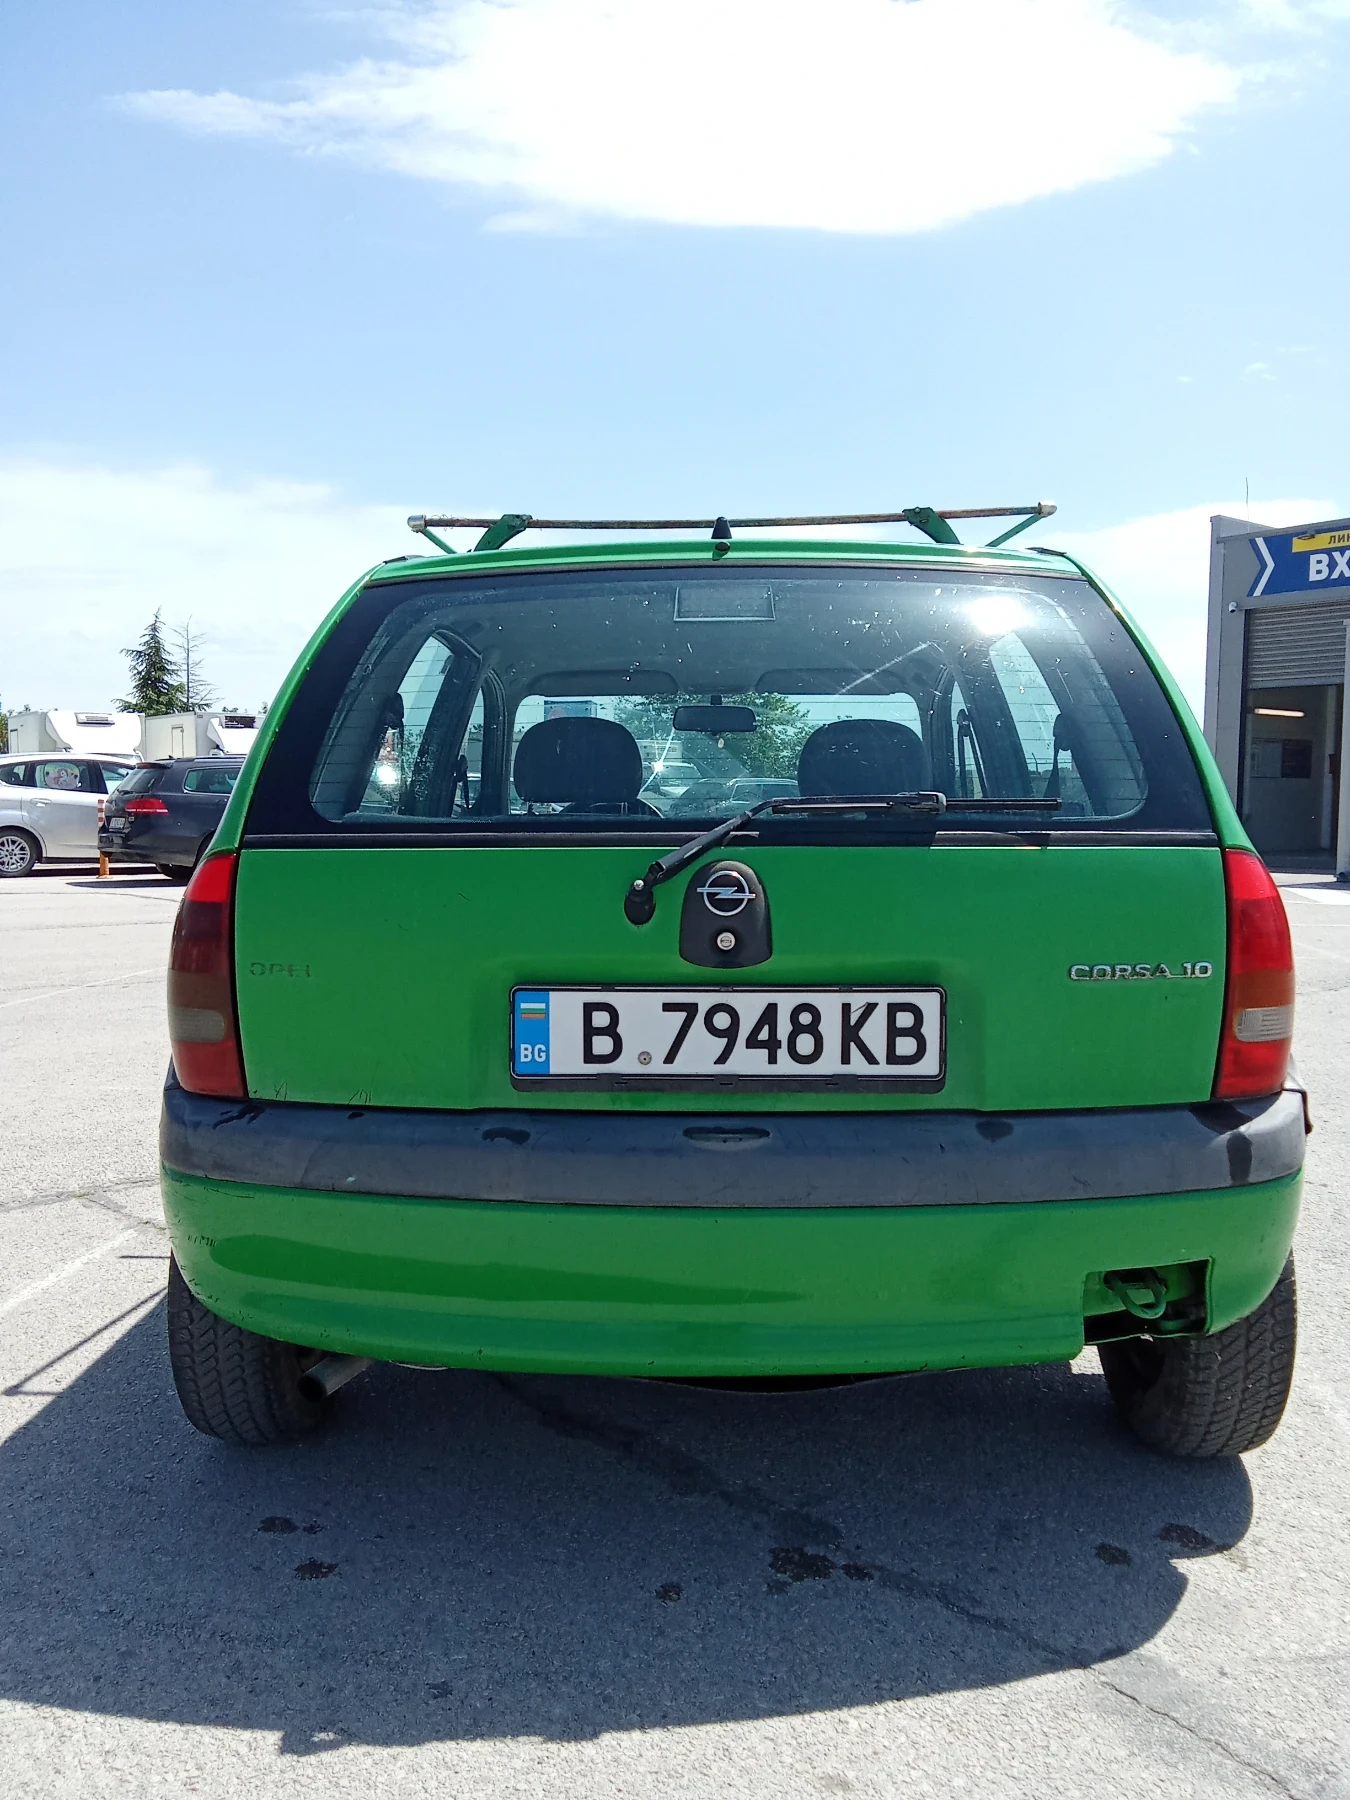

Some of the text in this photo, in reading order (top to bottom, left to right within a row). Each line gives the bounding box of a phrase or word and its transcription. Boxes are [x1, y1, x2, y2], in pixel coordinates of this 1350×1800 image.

[1070, 963, 1171, 980] CORSA
[582, 1002, 928, 1065] B 7948 KB
[520, 1043, 546, 1062] BG
